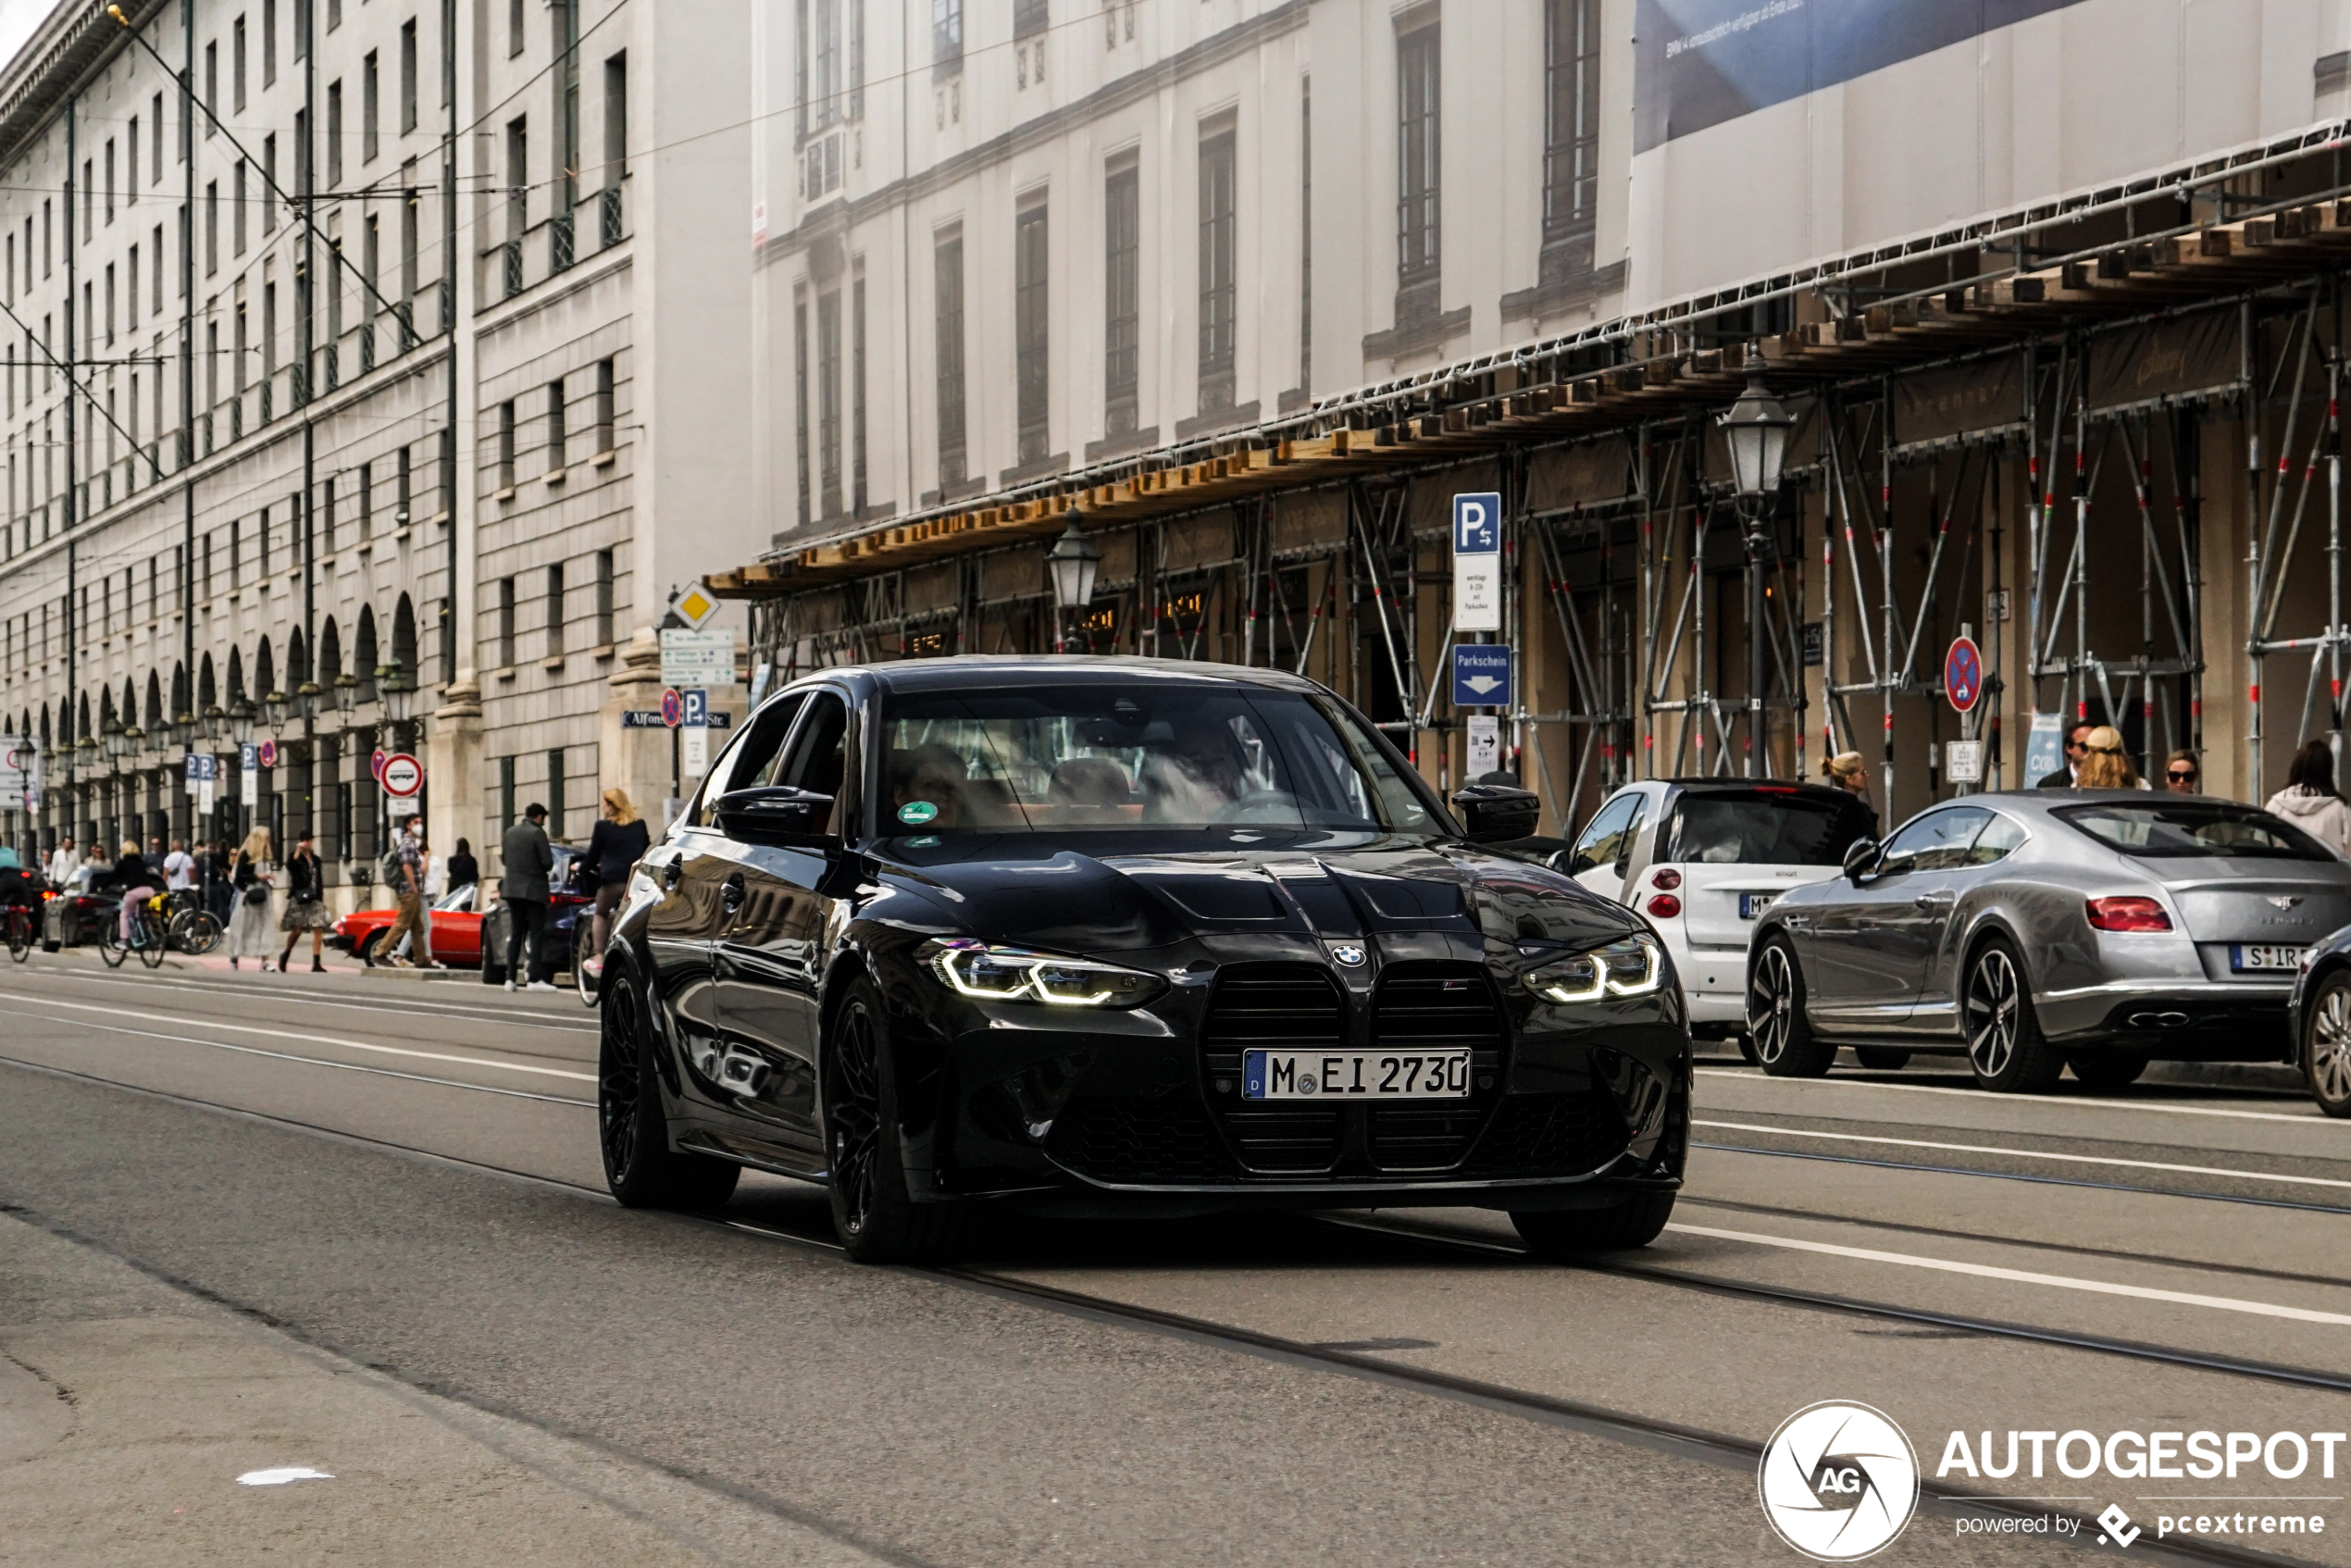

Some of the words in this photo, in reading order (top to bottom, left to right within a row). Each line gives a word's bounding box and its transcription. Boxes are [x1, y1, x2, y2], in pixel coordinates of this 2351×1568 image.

[1667, 40, 1682, 58] BMW
[1461, 502, 1486, 547] P
[1458, 654, 1507, 666] Parkschein
[687, 695, 701, 722] P
[914, 804, 923, 813] 4
[1751, 898, 1761, 914] M
[2251, 948, 2262, 966] S
[1250, 1080, 1259, 1090] D
[1272, 1057, 1295, 1093] M
[1322, 1057, 1366, 1093] EI
[1379, 1056, 1468, 1093] 2730
